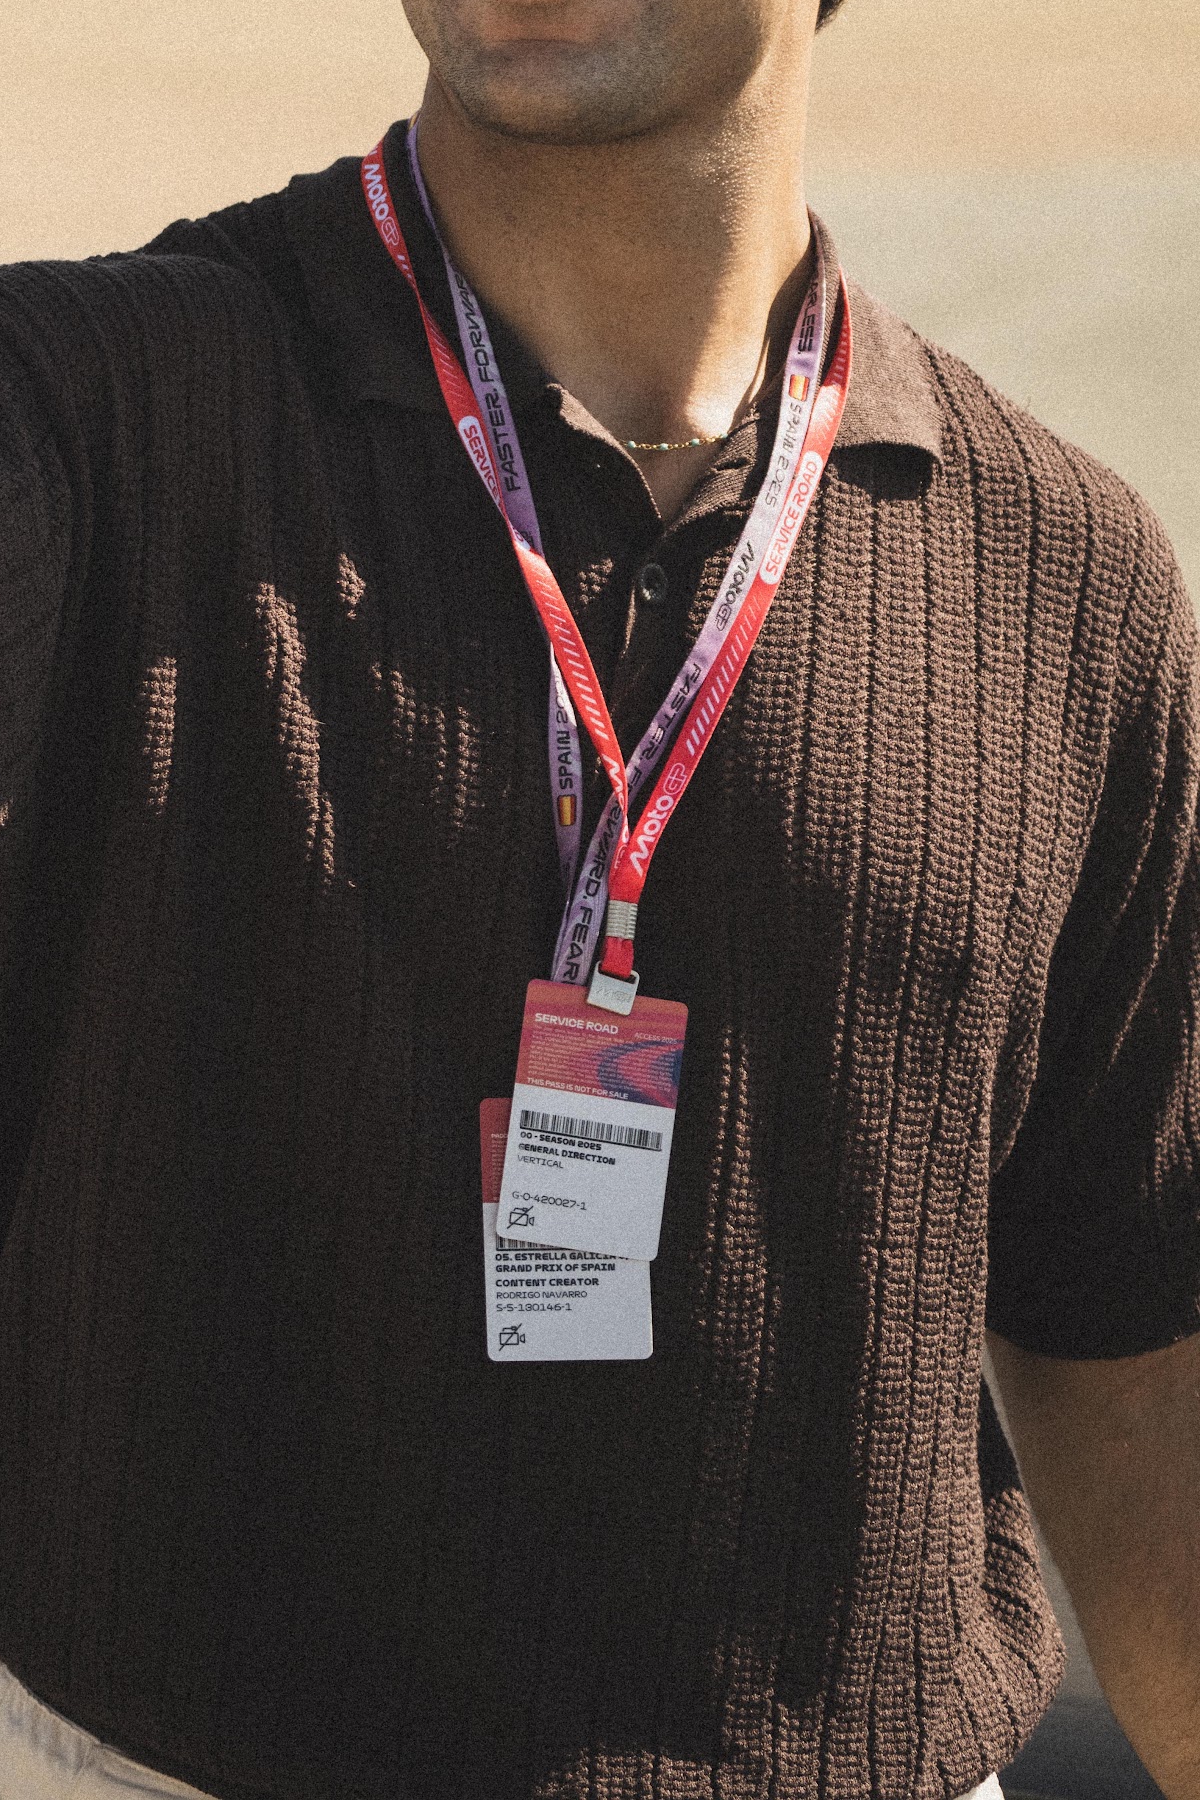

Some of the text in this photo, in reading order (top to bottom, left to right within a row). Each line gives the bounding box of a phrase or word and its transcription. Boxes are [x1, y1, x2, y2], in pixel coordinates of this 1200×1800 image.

[364, 163, 400, 246] MotoGP
[455, 272, 496, 384] FORWAR
[765, 460, 819, 576] SERVICE ROAD
[557, 730, 574, 790] SPAIN
[630, 762, 688, 878] MotoGP
[534, 1013, 619, 1035] SERVICE ROAD
[634, 1032, 661, 1042] ACCESS
[527, 1077, 629, 1100] THIS PASS IS NOT FOR SALE
[539, 1134, 576, 1147] SEASON
[577, 1140, 602, 1151] 2025
[517, 1154, 564, 1169] VERTICAL
[518, 1143, 616, 1165] GENERAL DIRECTION
[495, 1263, 616, 1273] GRAND PRIX OF SPAIN
[514, 1252, 567, 1262] ESTRELLA
[495, 1277, 600, 1287] CONTENT CREATOR
[496, 1290, 588, 1299] RODRIGO NAVARRO
